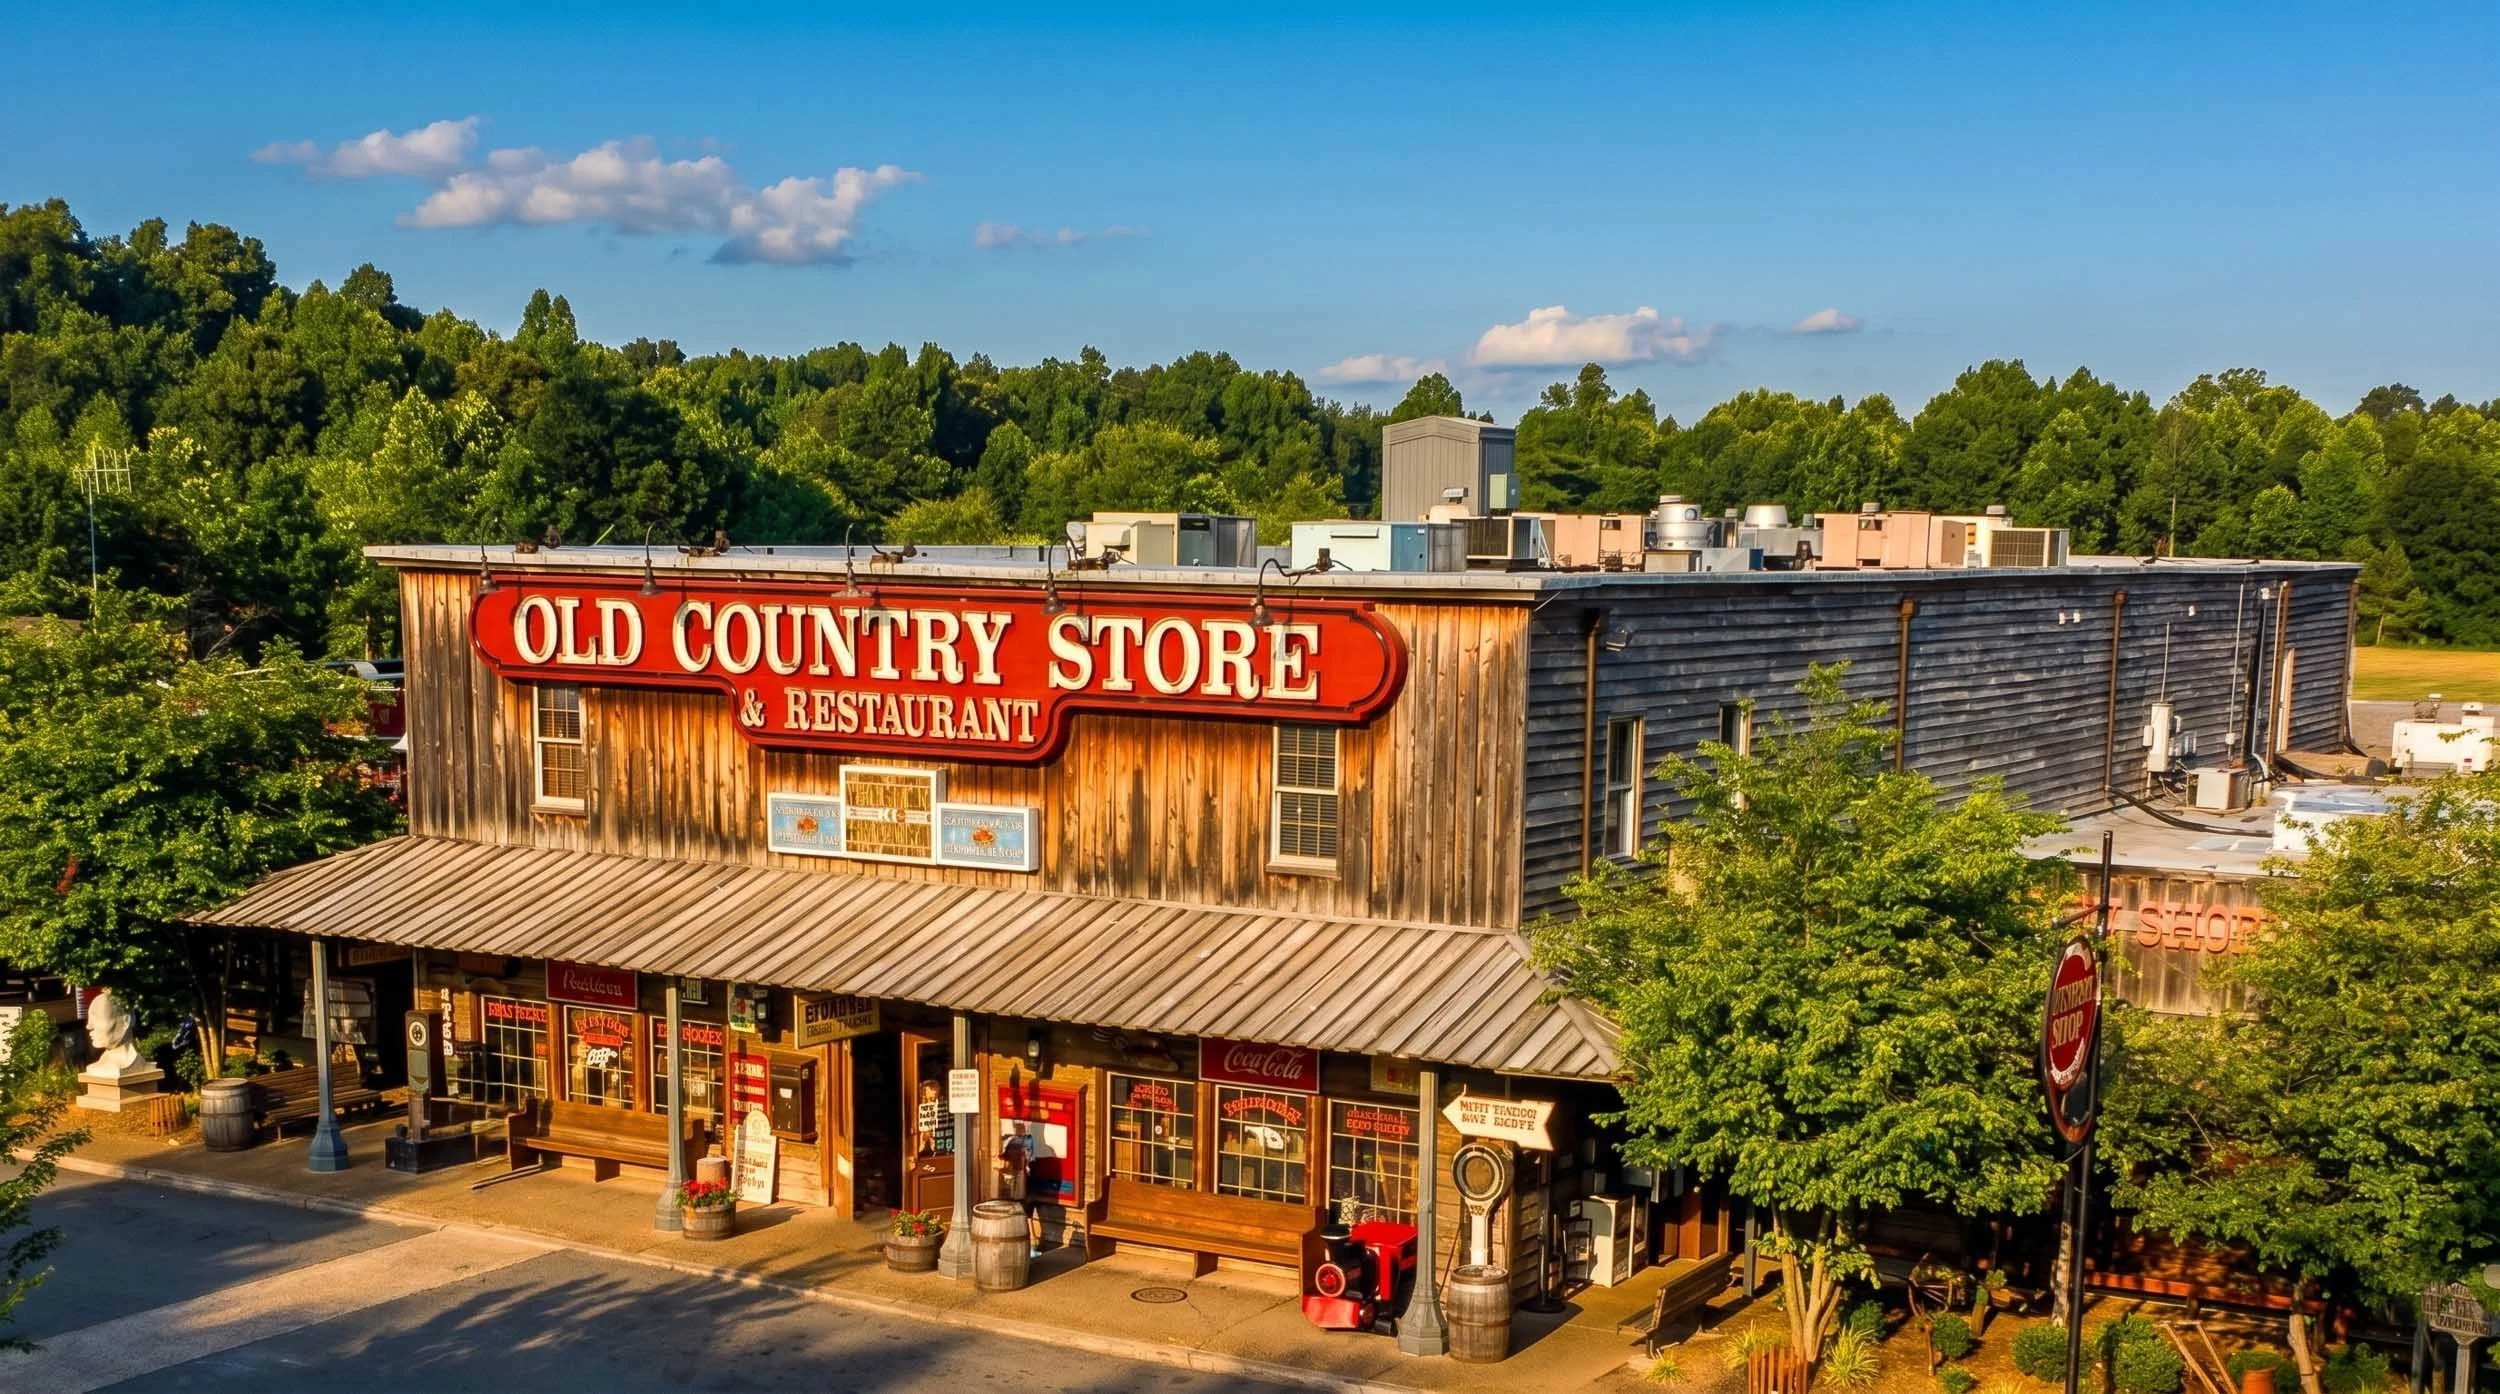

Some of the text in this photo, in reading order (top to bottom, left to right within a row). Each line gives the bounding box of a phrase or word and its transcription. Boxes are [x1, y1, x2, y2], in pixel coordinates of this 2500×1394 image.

[513, 594, 1318, 700] OLD COUNTRY STORE
[740, 686, 1038, 743] & RESTAURANT
